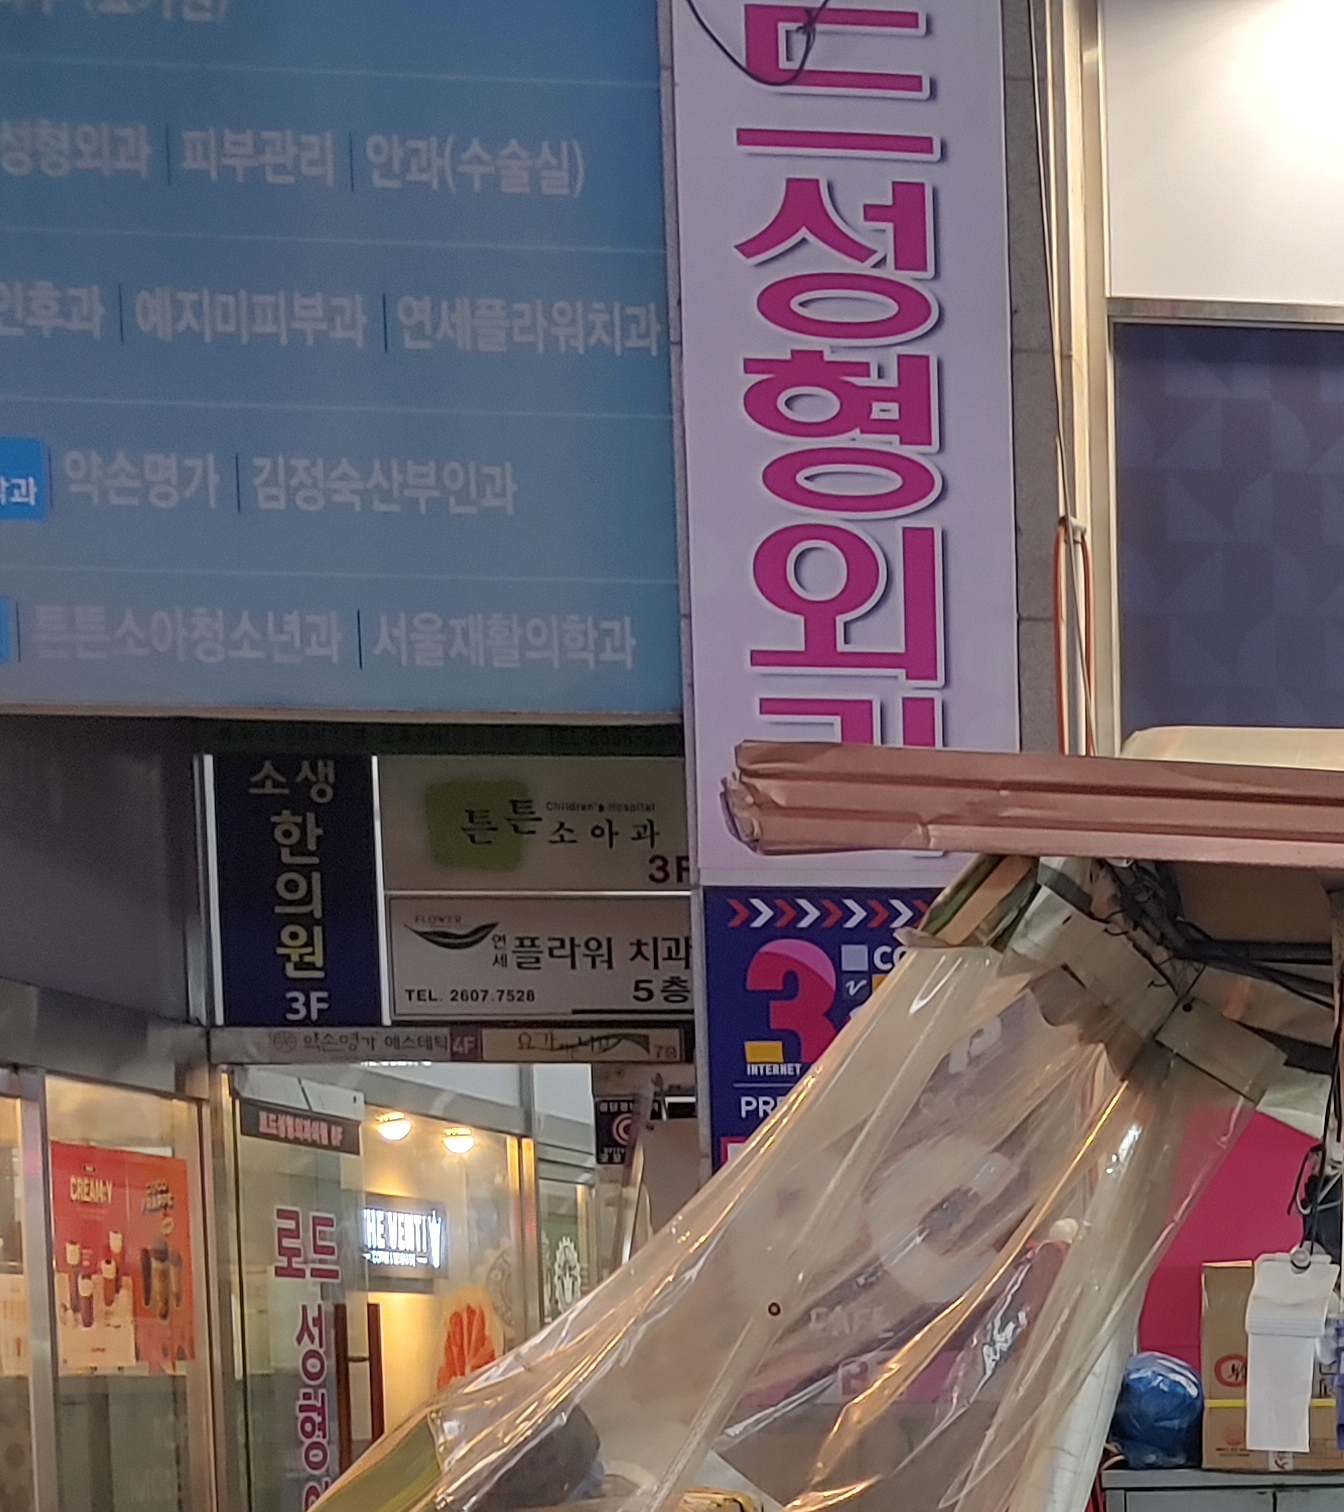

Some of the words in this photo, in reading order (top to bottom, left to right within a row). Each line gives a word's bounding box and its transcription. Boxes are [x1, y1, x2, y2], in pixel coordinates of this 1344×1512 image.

[181, 130, 336, 187] 피부관리
[365, 133, 588, 198] 안과(수술실)
[134, 287, 368, 349] 예지미피부과
[397, 295, 664, 357] 연세플라워치과
[63, 449, 221, 508] 약손명가
[251, 455, 518, 517] 김정숙산부인과
[33, 606, 343, 666] 튼튼소아청소년과
[373, 612, 637, 670] 서울재활의학과
[247, 757, 339, 805] 소생
[460, 798, 543, 846] 튼튼
[547, 818, 661, 850] 소아과
[270, 808, 326, 981] 한의원
[511, 935, 615, 971] 플라워
[629, 936, 692, 971] 치과
[284, 989, 331, 1023] 3F
[631, 976, 692, 1005] 5층
[451, 1035, 476, 1055] 4F
[746, 1062, 802, 1077] INTERNET
[274, 1205, 342, 1282] 로드
